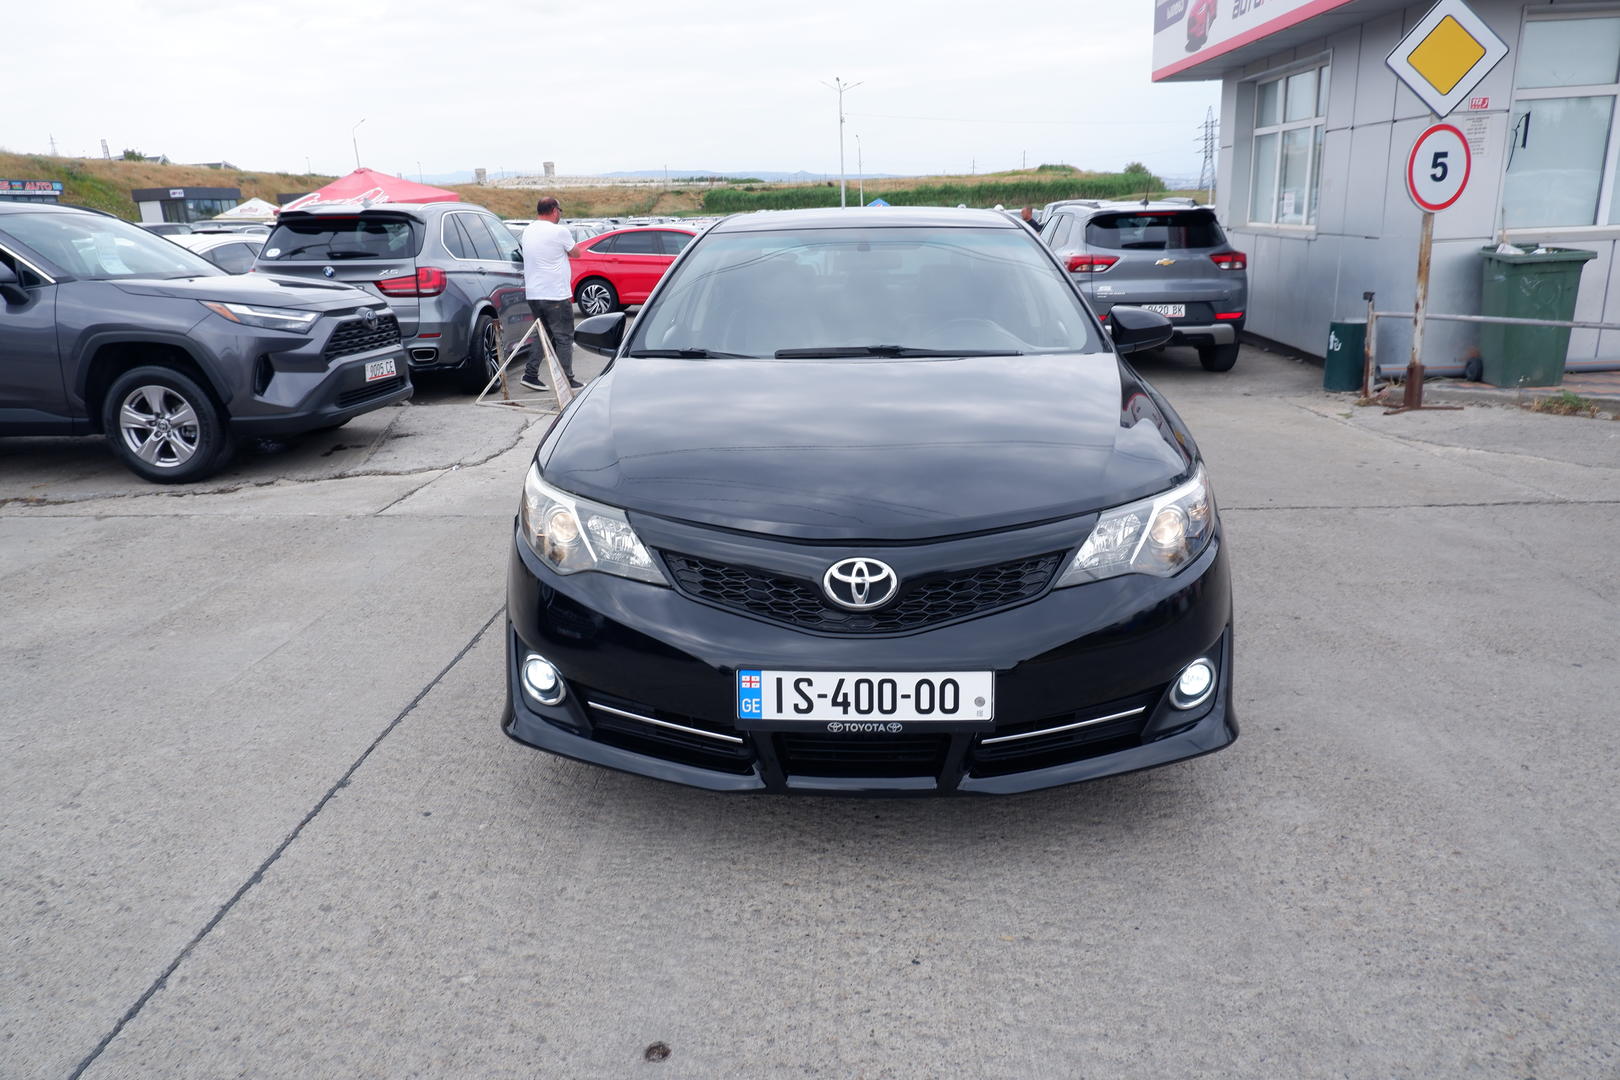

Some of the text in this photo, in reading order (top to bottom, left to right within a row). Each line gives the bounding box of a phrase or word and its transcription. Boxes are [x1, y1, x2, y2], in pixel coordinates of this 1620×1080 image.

[1430, 151, 1448, 182] 5
[1173, 305, 1183, 315] BK
[776, 677, 960, 715] IS-400-00
[742, 698, 760, 713] GE
[845, 722, 886, 732] TOYOTA
